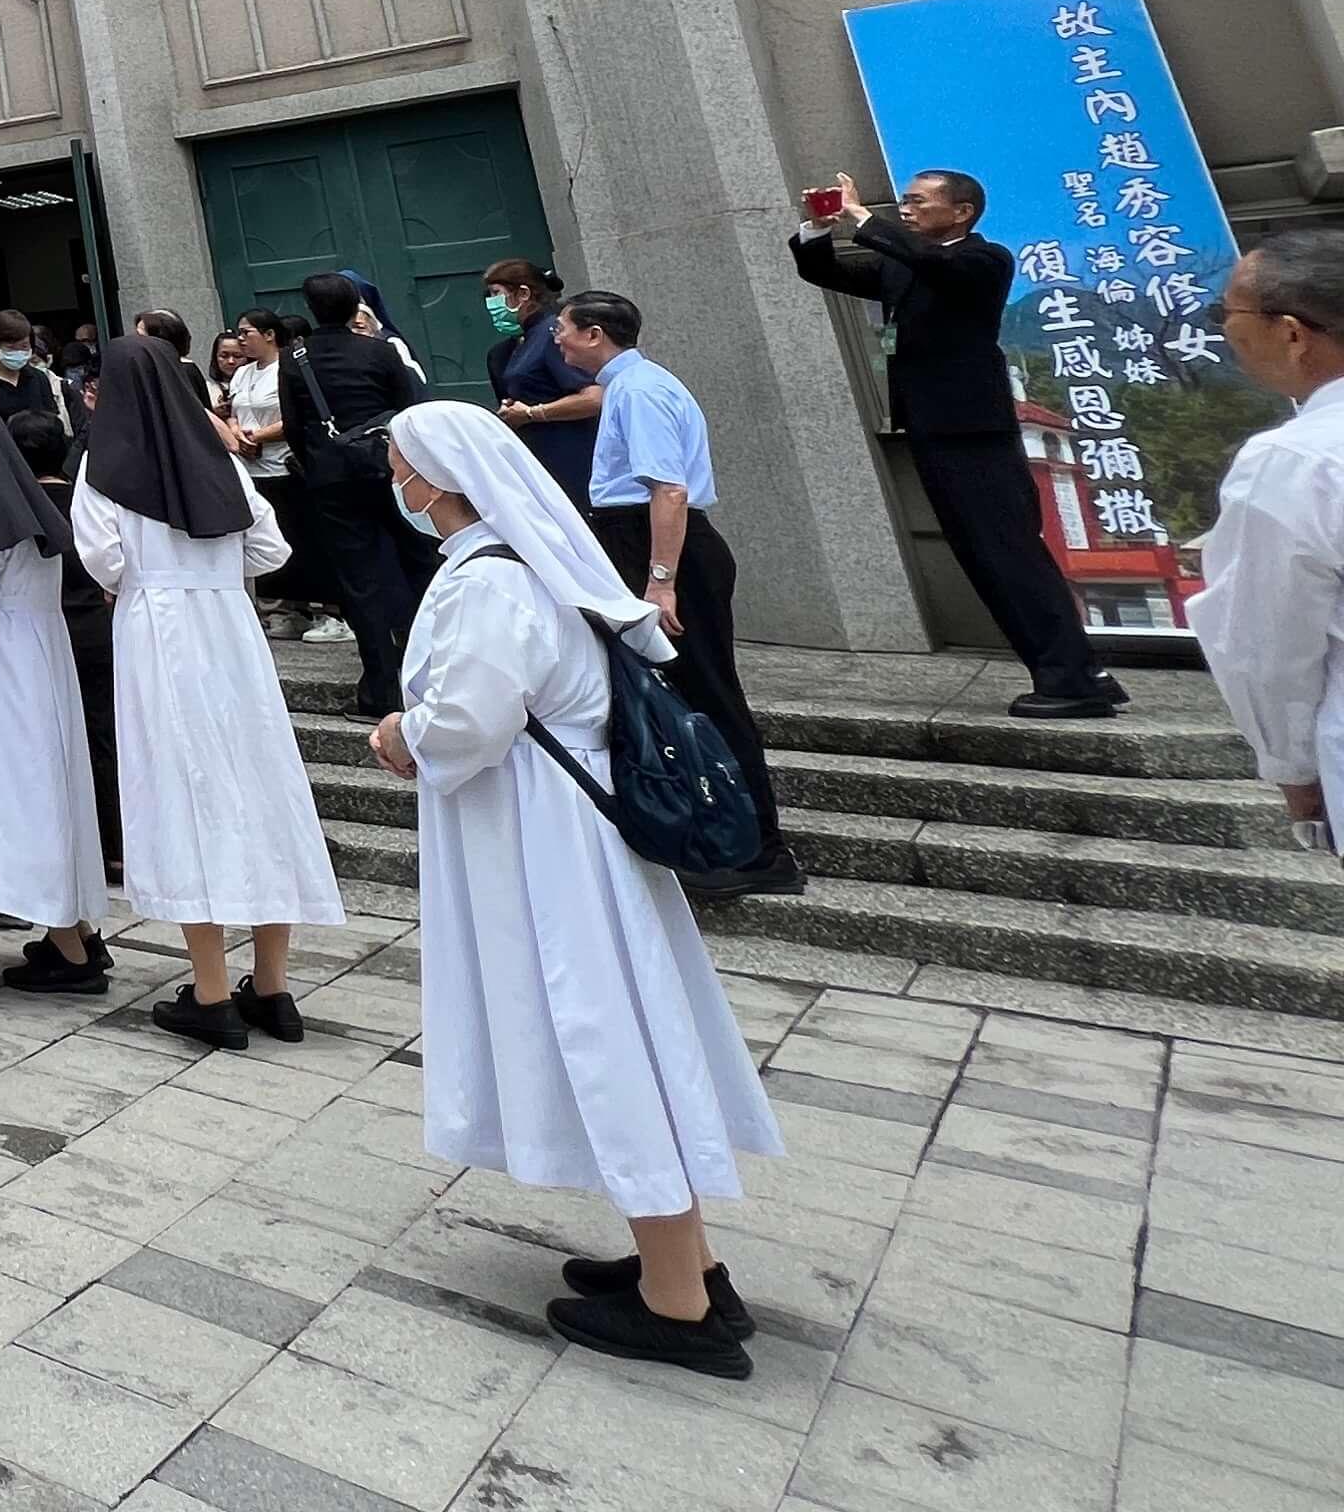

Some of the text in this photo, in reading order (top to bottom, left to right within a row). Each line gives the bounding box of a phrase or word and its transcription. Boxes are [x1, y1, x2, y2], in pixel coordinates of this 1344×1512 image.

[1052, 0, 1225, 366] 故主內趙秀容修女
[1062, 170, 1111, 229] 聖名
[1086, 245, 1138, 305] 海倫
[1018, 239, 1167, 537] 復生感恩彌撒
